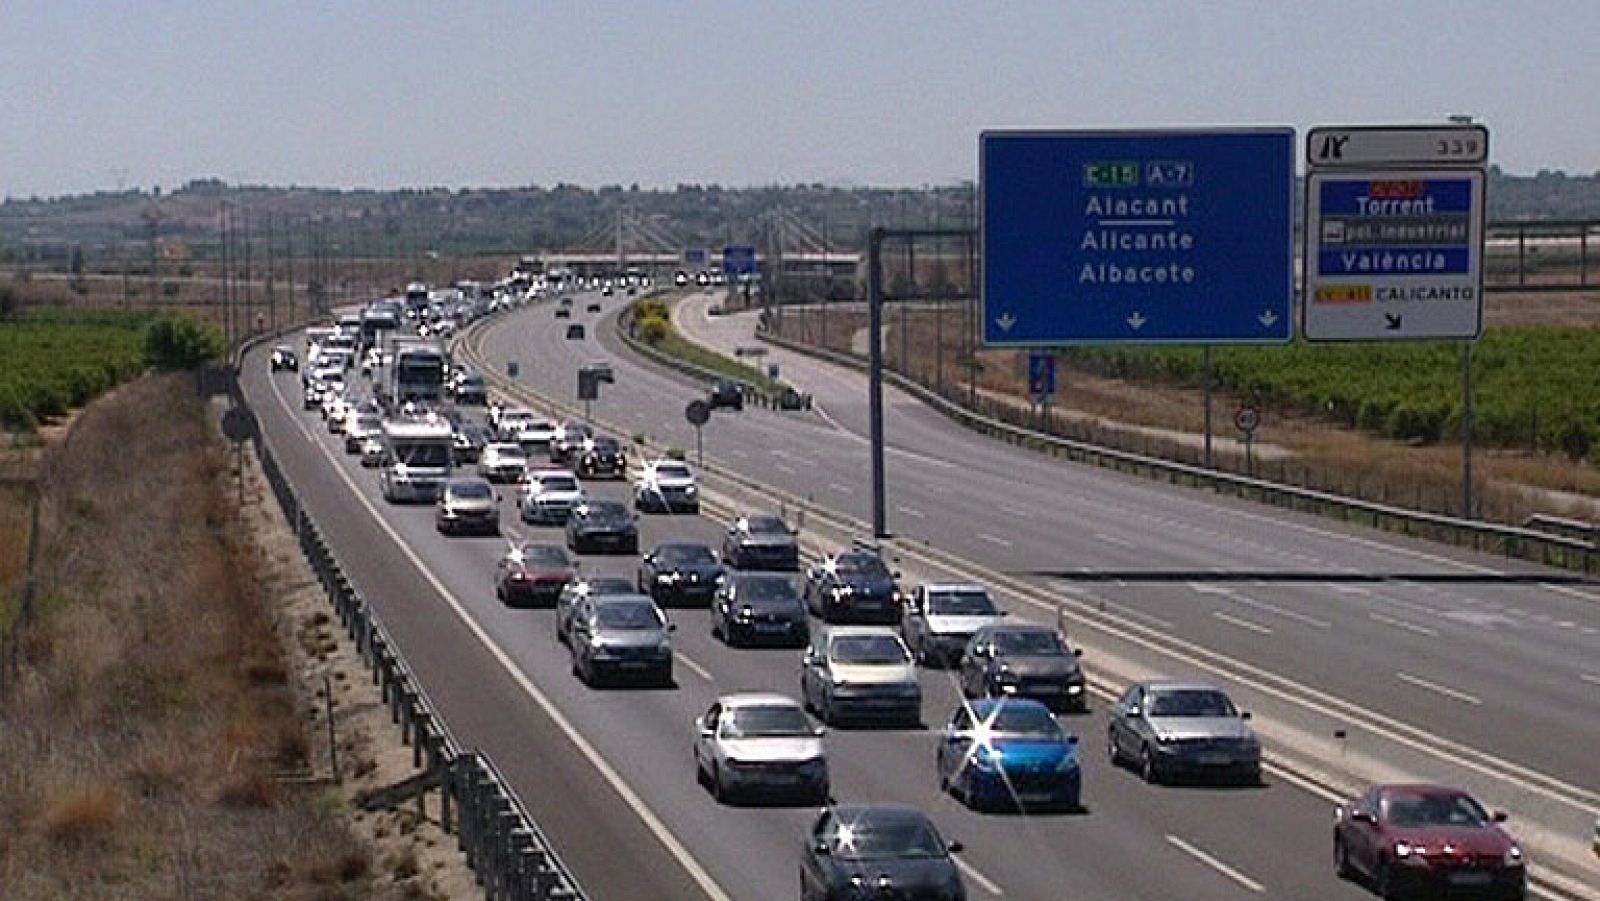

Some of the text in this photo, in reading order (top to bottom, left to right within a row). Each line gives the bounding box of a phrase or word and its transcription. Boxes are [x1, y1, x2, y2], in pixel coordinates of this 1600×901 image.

[1151, 165, 1187, 182] A-7
[1086, 196, 1189, 216] Alacant
[1355, 197, 1434, 216] Torrent
[1081, 230, 1193, 250] Alicante
[1080, 263, 1194, 284] Albacete
[1376, 286, 1474, 301] CALICANTO
